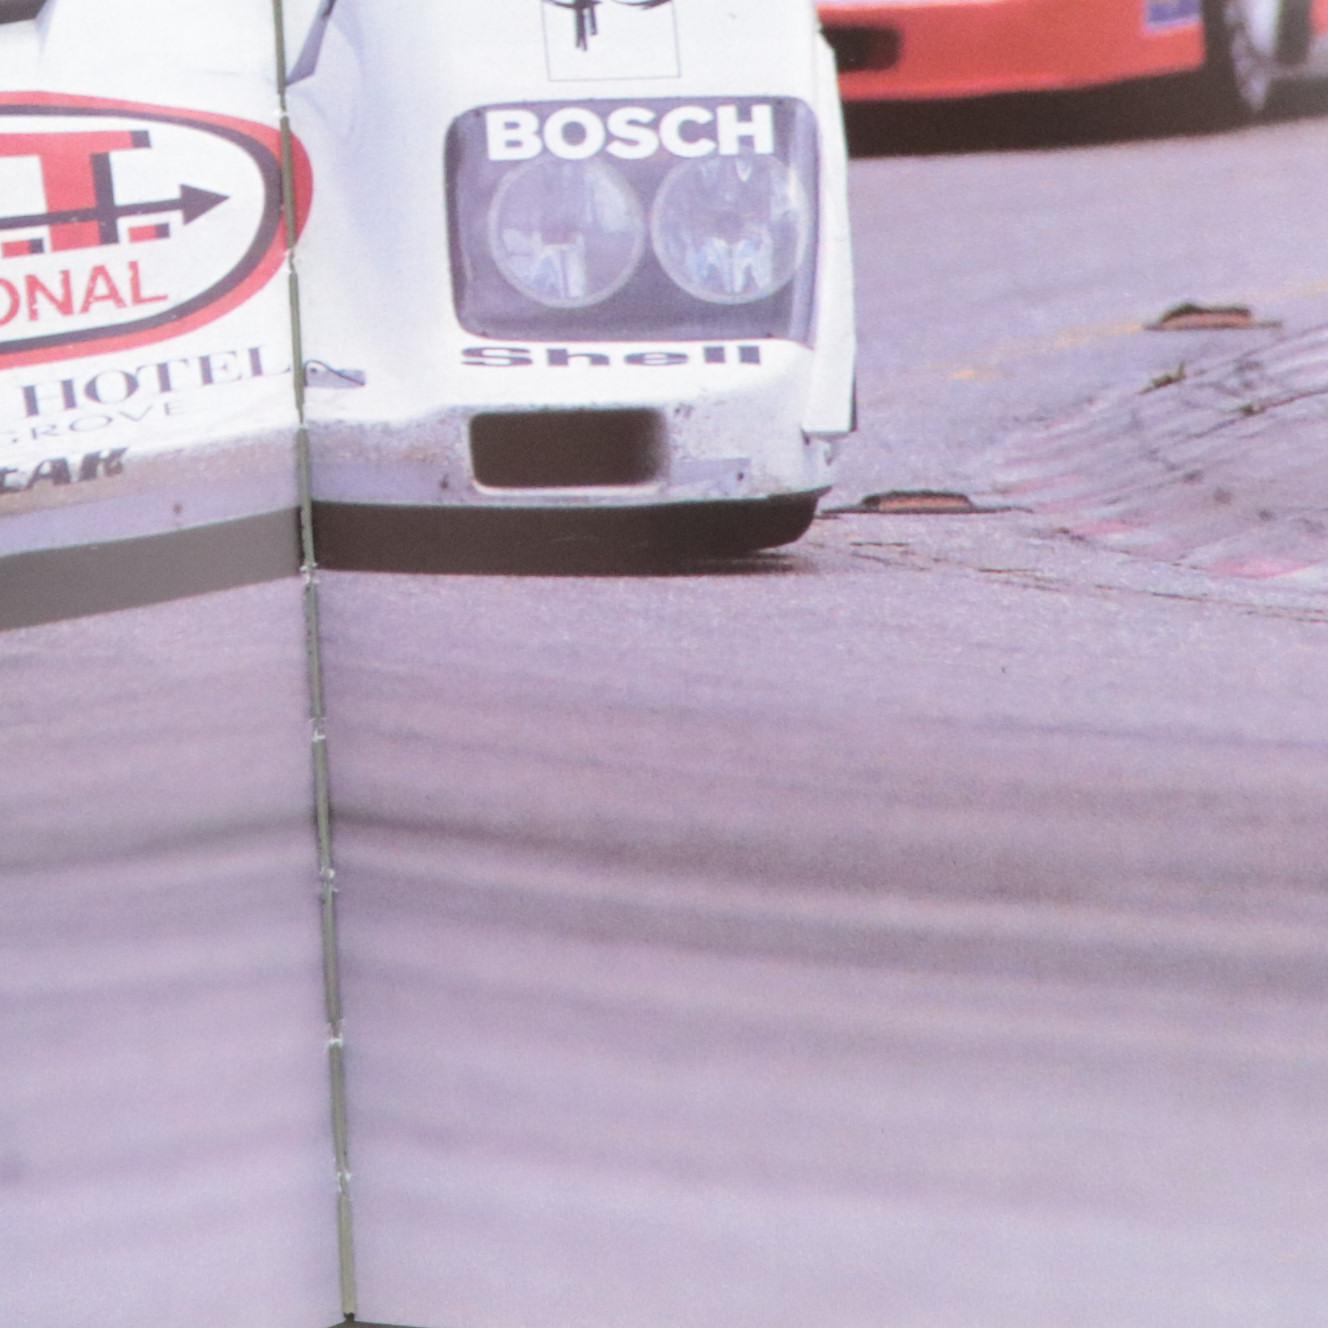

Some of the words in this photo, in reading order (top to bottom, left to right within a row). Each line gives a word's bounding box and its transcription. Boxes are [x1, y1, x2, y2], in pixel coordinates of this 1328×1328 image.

[484, 103, 774, 161] BOSCH
[21, 345, 294, 418] HOTEL
[461, 344, 762, 367] Shell
